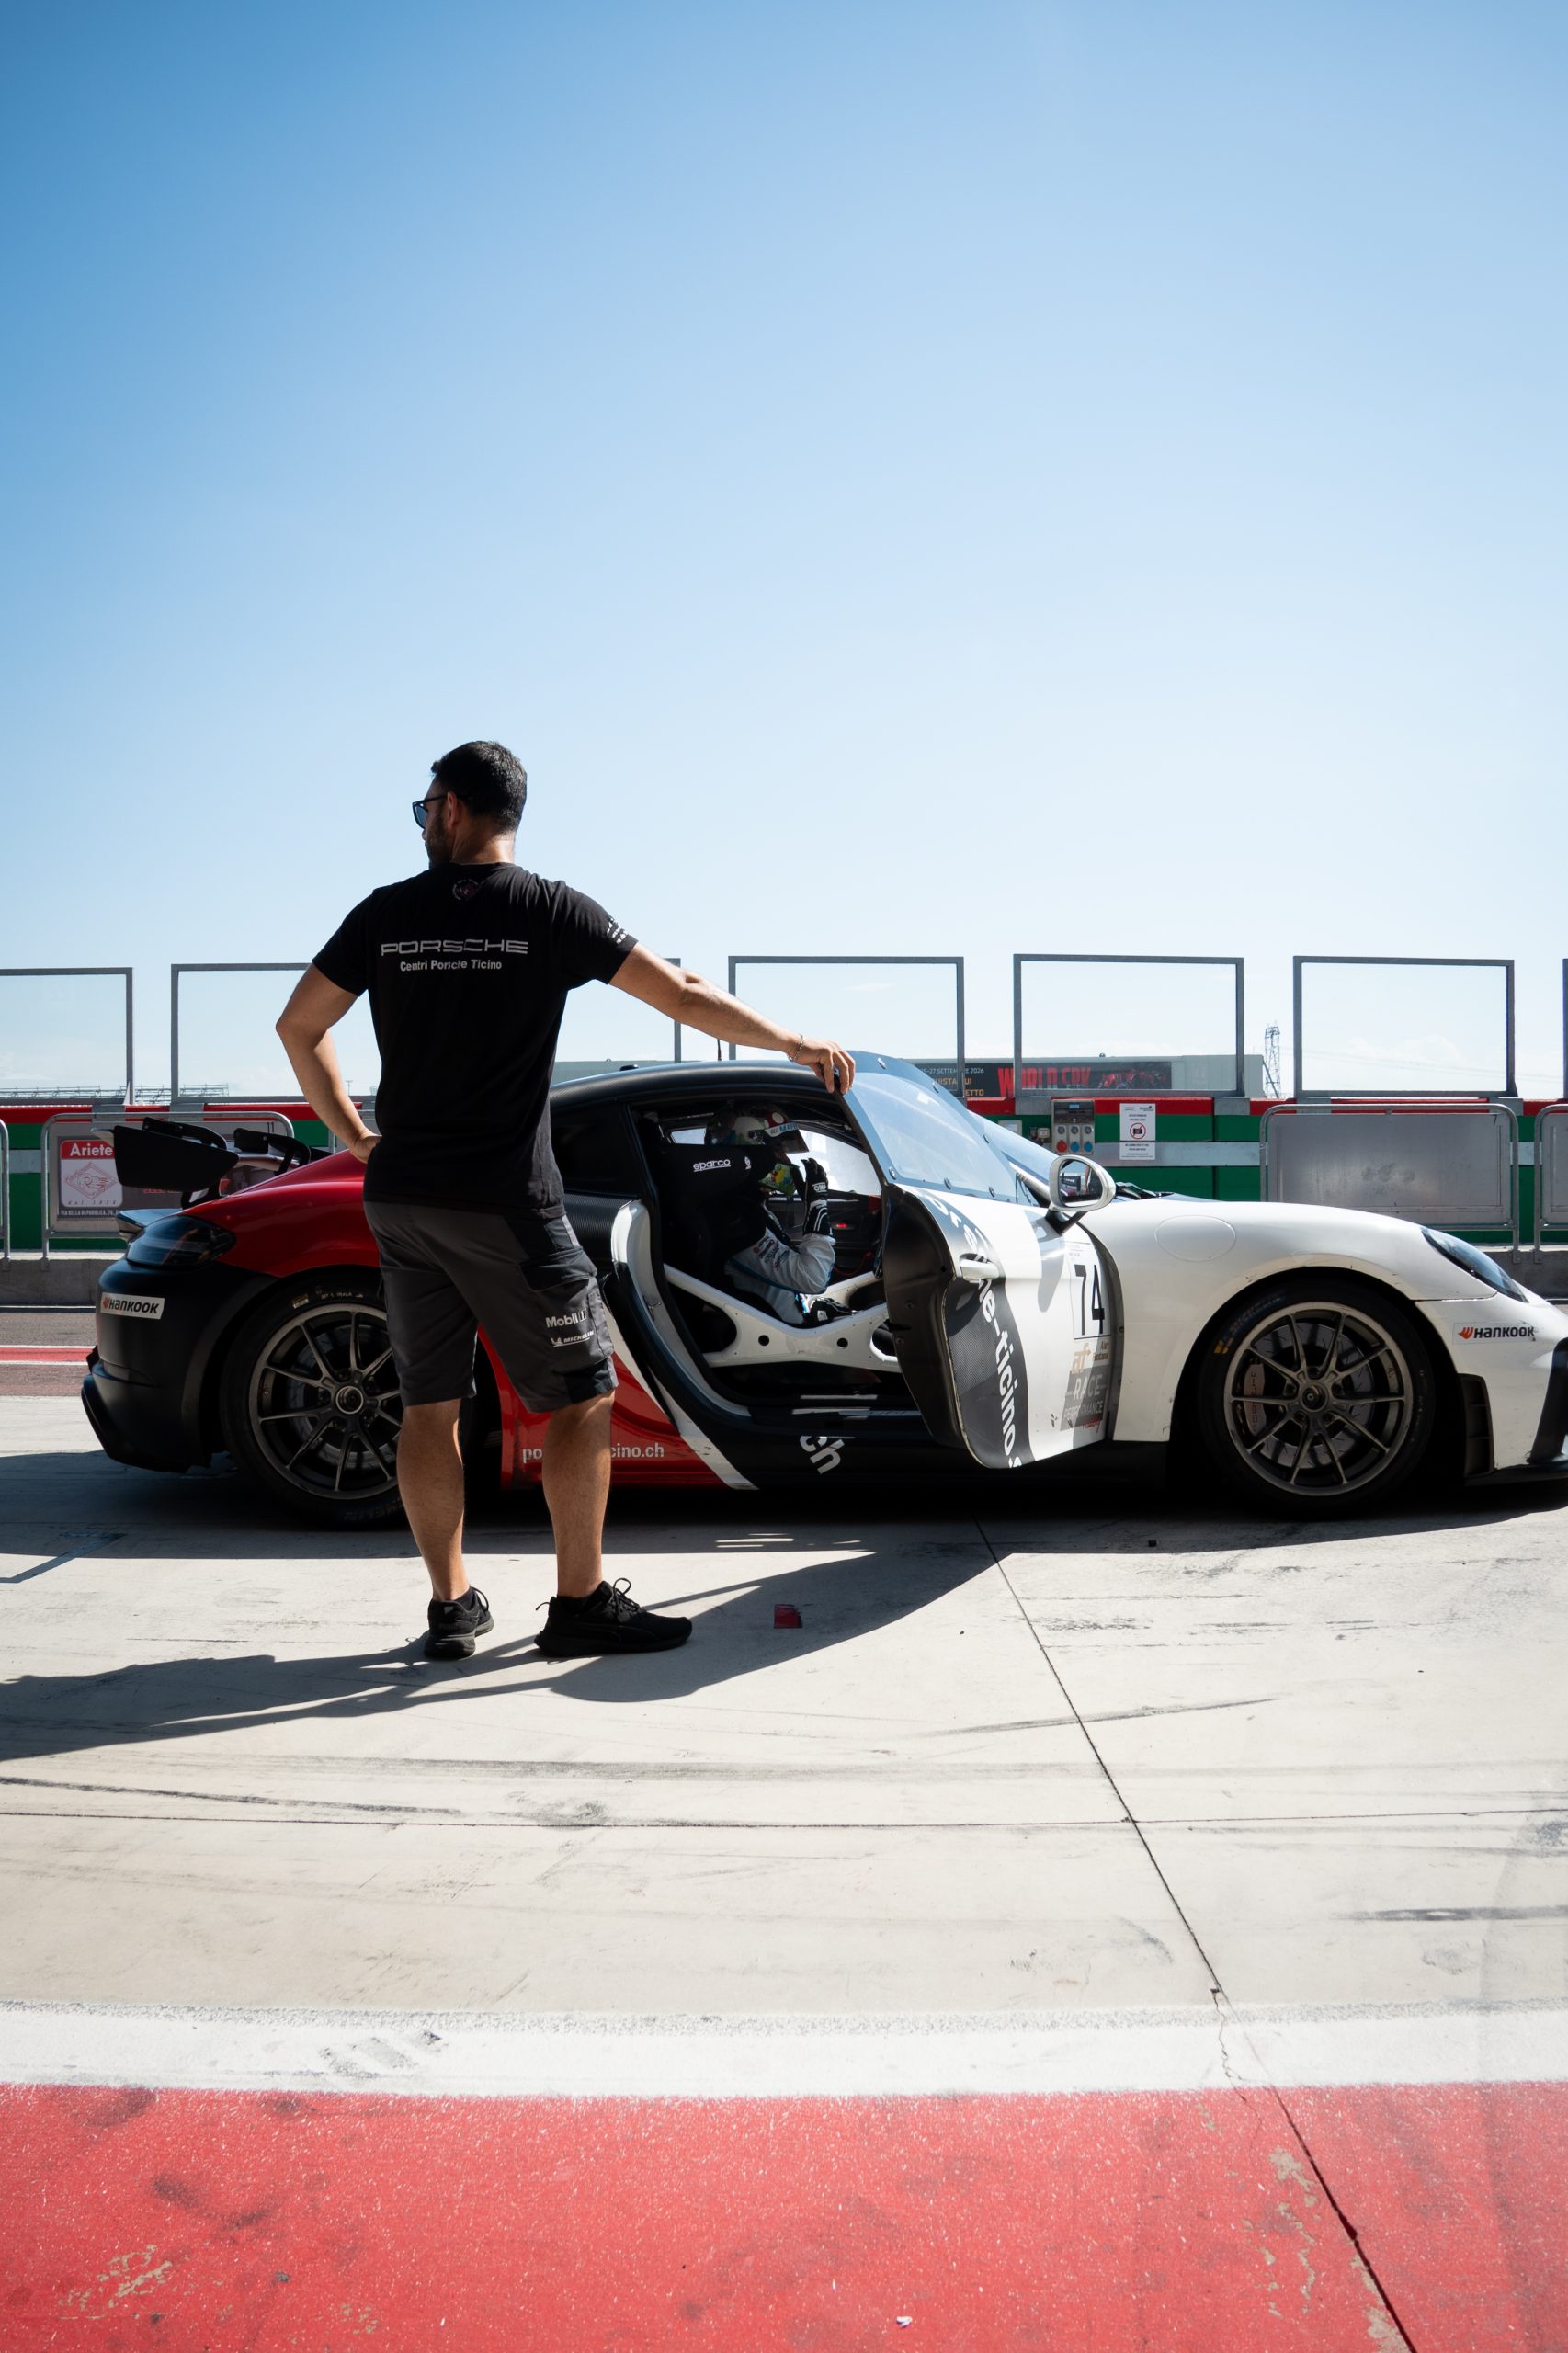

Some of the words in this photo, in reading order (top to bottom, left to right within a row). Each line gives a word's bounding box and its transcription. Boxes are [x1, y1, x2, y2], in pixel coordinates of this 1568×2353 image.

[381, 938, 529, 956] PORSCHE
[400, 960, 428, 972] Centri
[430, 959, 468, 971] Porsche
[471, 959, 503, 970] Ticino
[70, 1142, 114, 1156] Ariete
[693, 1158, 732, 1172] sparco
[1074, 1263, 1106, 1336] 74
[545, 1312, 579, 1329] Mobil
[563, 1330, 595, 1344] MICHELIN
[1073, 1374, 1103, 1401] RACE
